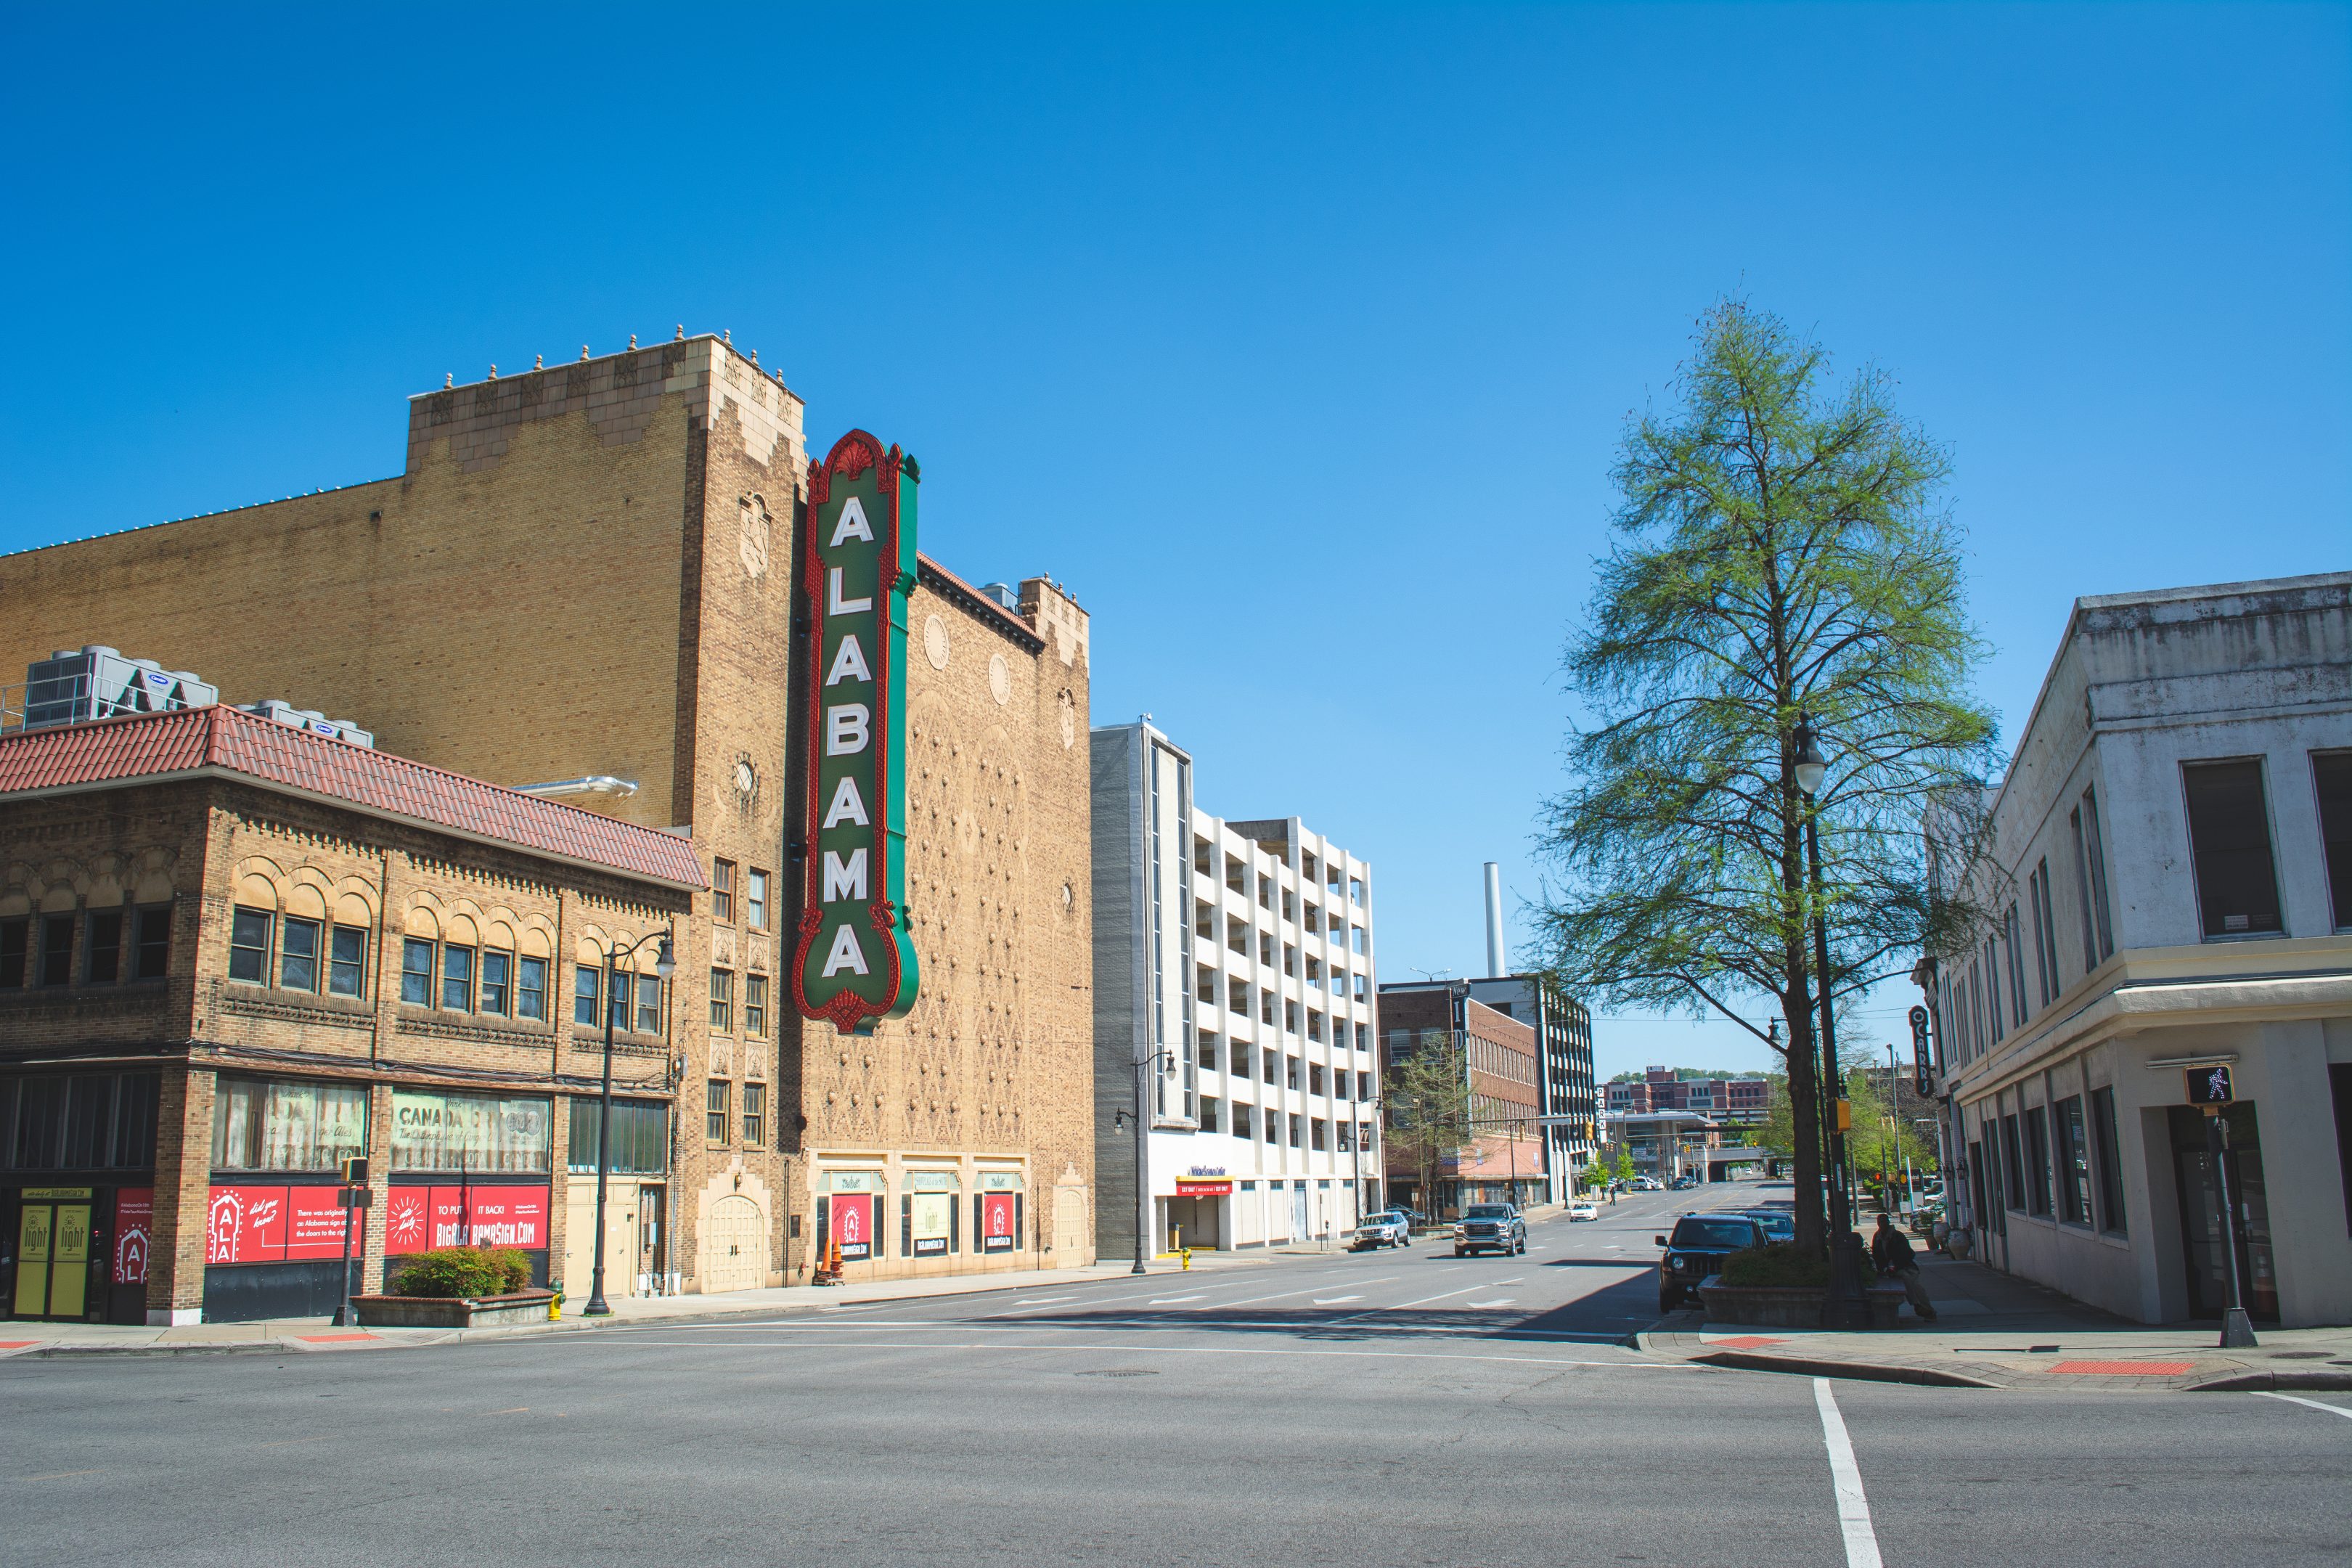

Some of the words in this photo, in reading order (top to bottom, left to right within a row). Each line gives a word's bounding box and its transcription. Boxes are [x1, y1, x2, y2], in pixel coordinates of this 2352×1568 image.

[821, 496, 874, 978] ALABAMA
[1453, 987, 1466, 996] New
[399, 1106, 464, 1127] CANADA
[249, 1199, 266, 1215] did
[263, 1199, 279, 1215] you
[324, 1209, 348, 1217] originally
[399, 1207, 414, 1220] vote
[438, 1206, 449, 1215] TO
[449, 1205, 463, 1214] PUT
[478, 1205, 484, 1214] IT
[485, 1205, 505, 1214] BACK!
[253, 1209, 277, 1228] know?
[329, 1219, 340, 1228] sign
[399, 1218, 416, 1230] daily
[25, 1226, 48, 1251] light
[60, 1226, 84, 1251] light
[217, 1208, 233, 1261] ALA
